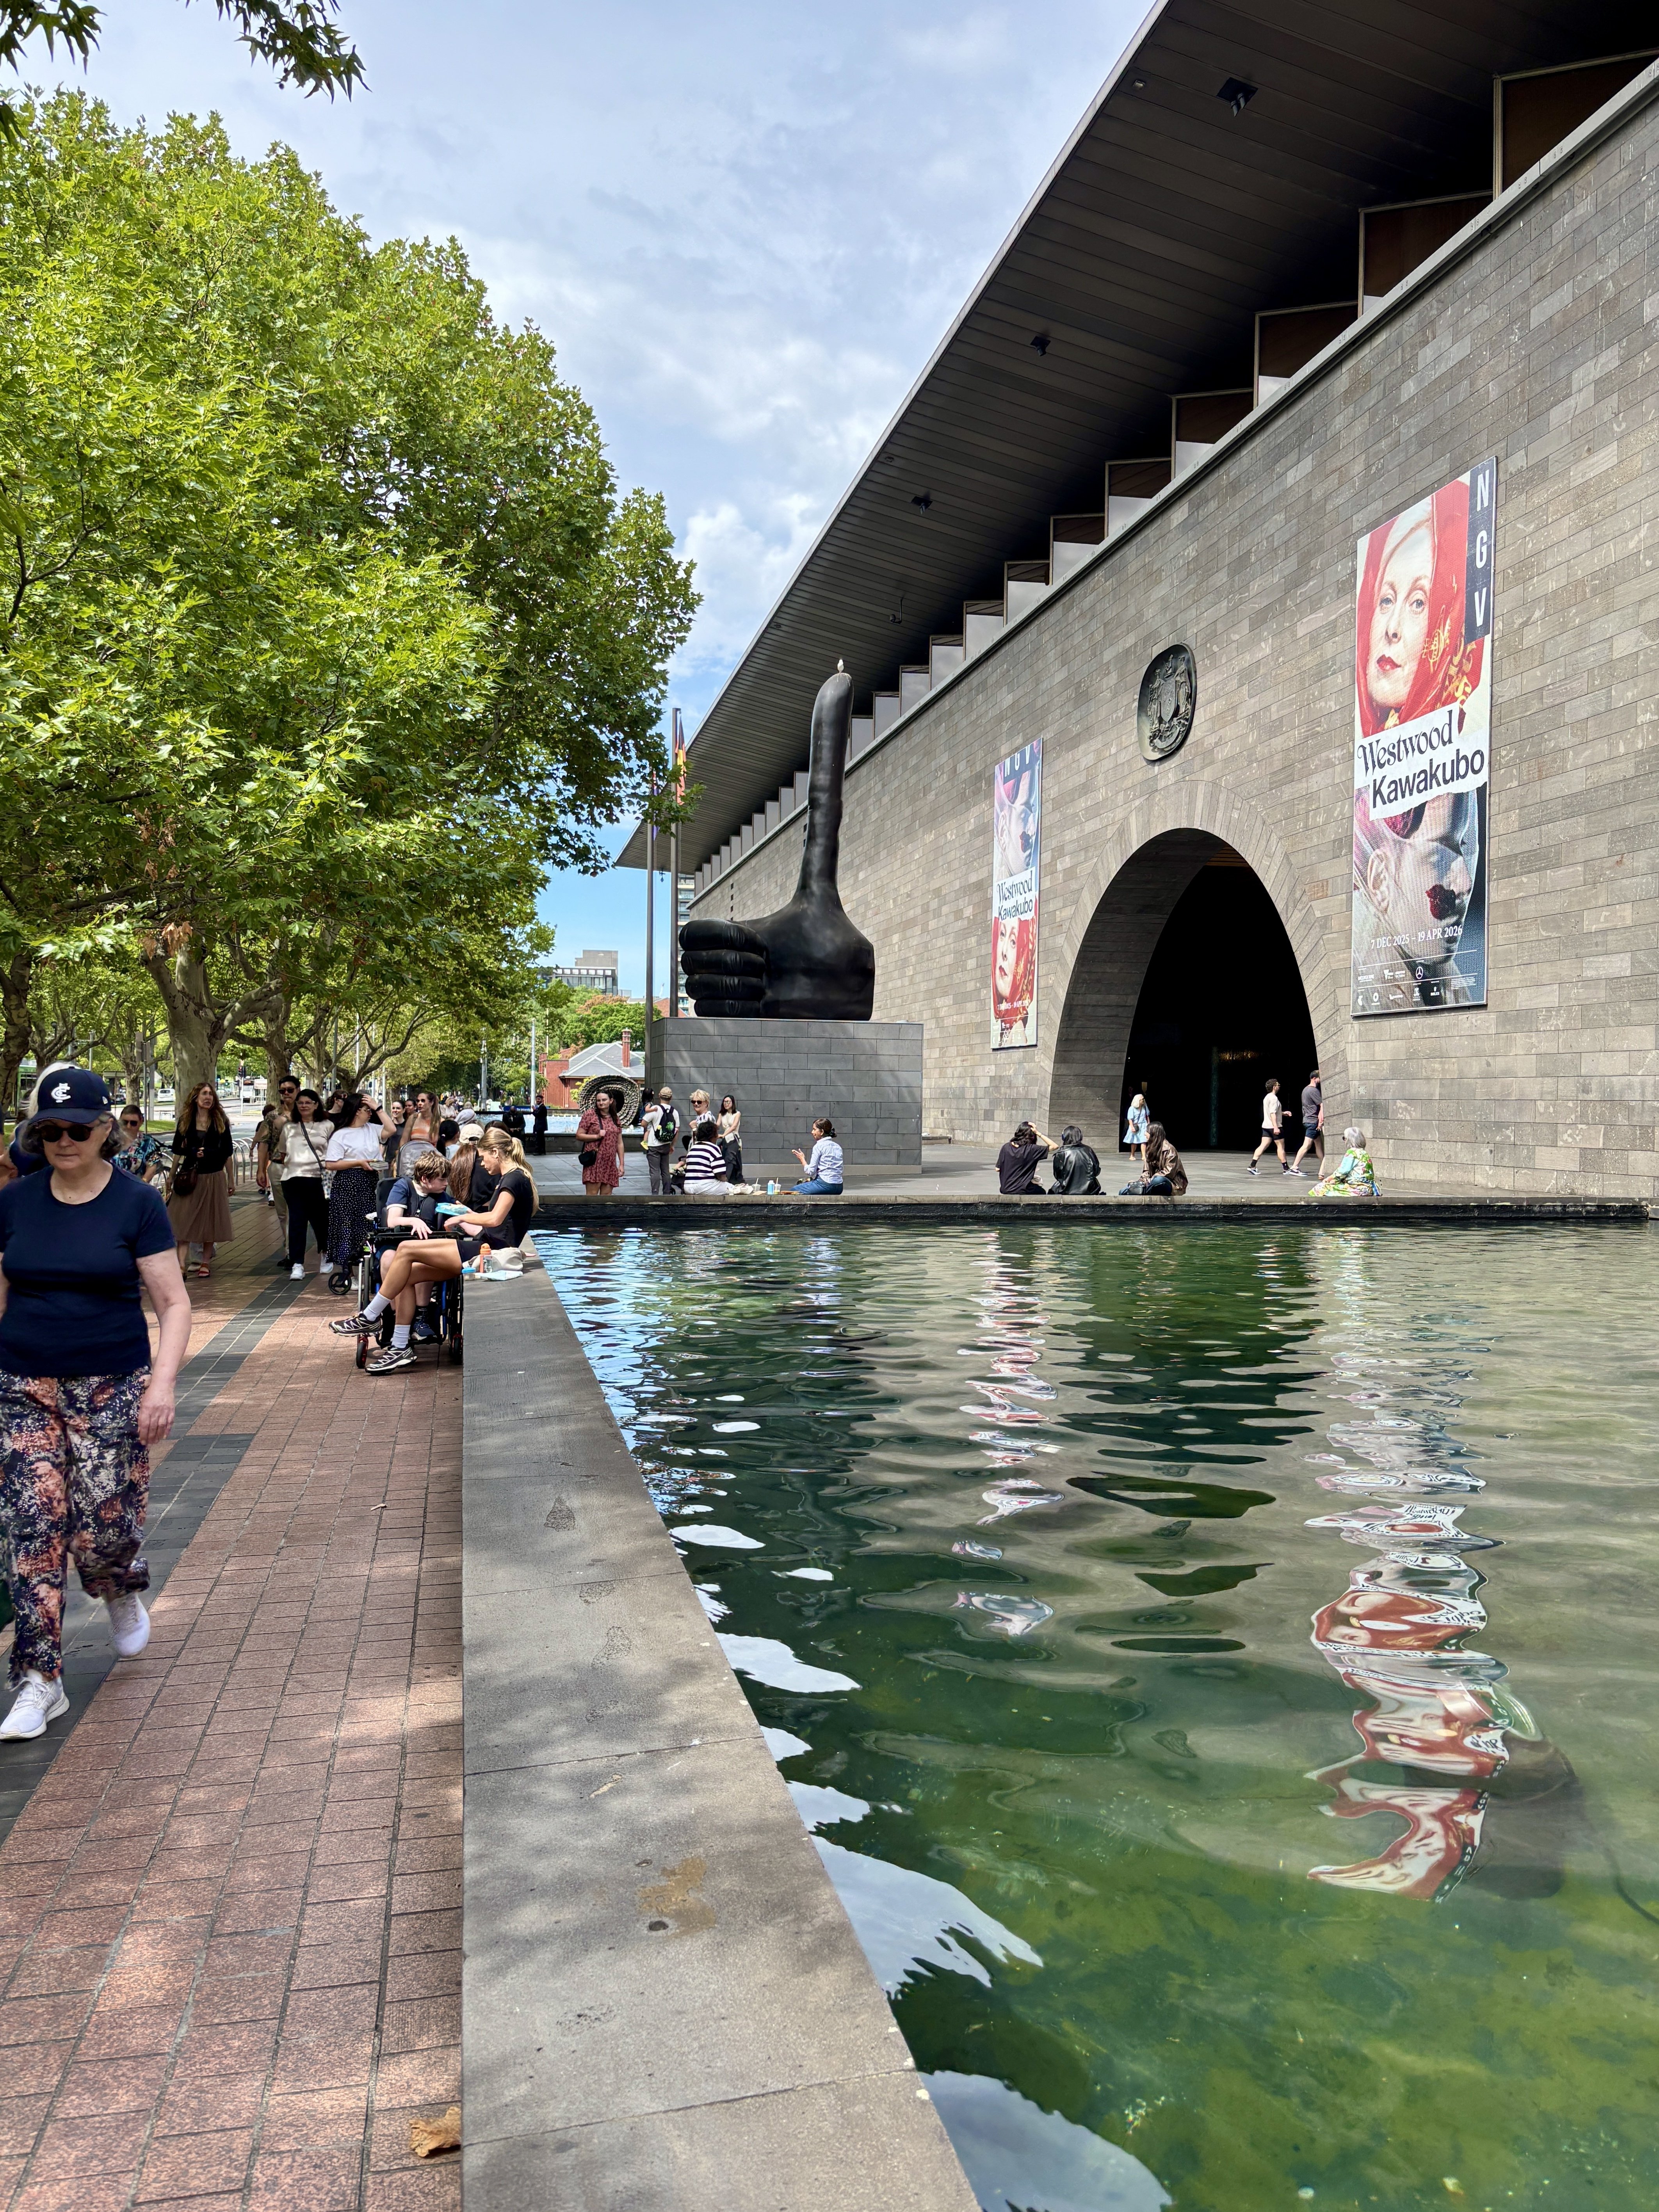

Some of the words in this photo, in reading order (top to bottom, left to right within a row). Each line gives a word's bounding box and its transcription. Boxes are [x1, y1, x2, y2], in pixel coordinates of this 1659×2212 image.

[1004, 744, 1031, 777] NGV
[1357, 710, 1453, 777] Westwood
[1373, 749, 1485, 808] Kawakubo
[997, 870, 1033, 905] Westwood
[998, 897, 1033, 921] Kawakubo
[1371, 940, 1375, 949] 7
[1377, 936, 1392, 949] DEC
[1393, 934, 1410, 946] 2025
[1418, 931, 1425, 942] 19
[1426, 927, 1442, 941] APR
[1444, 924, 1463, 938] 2026
